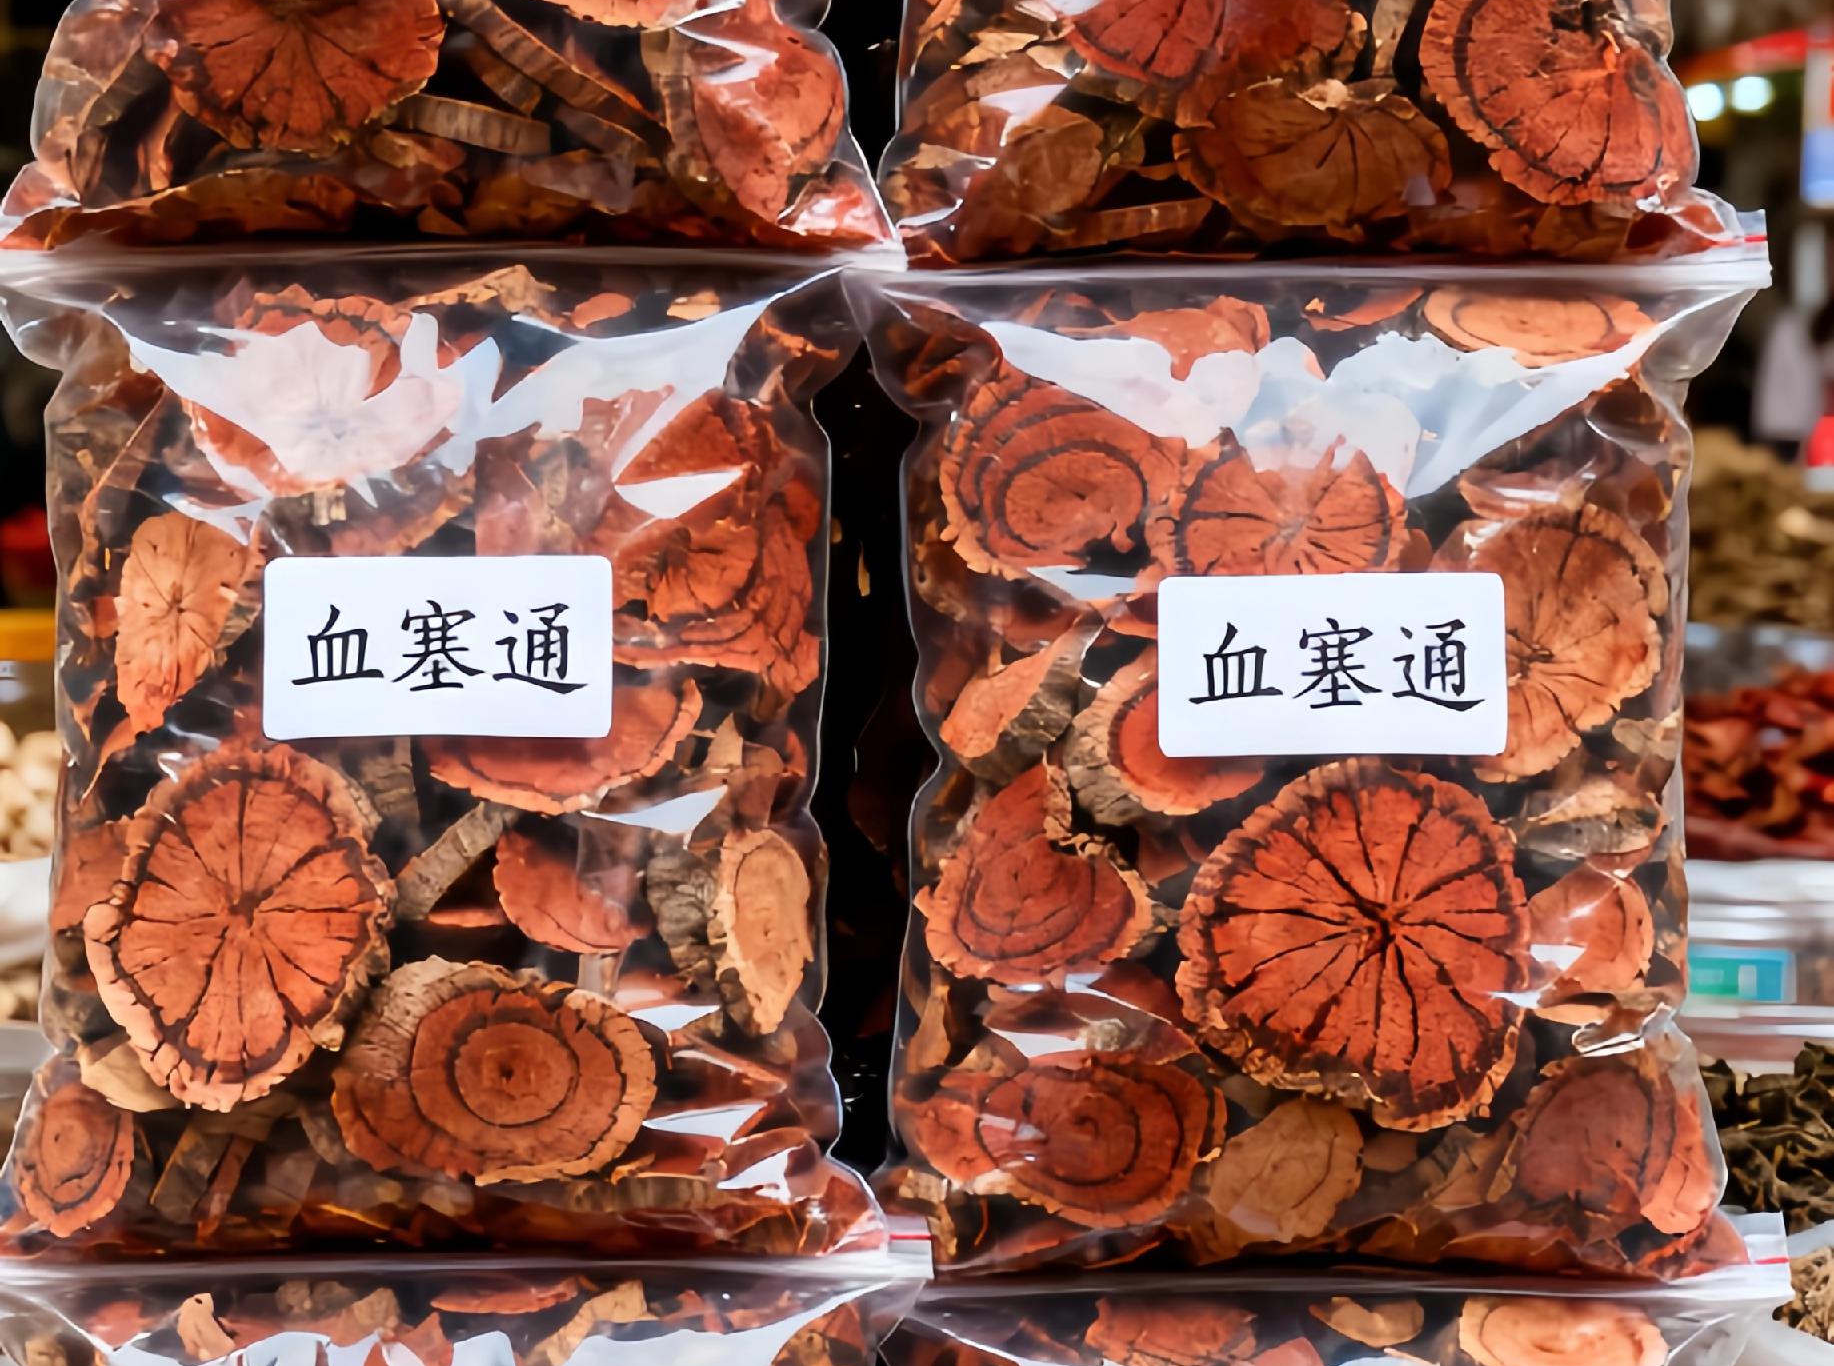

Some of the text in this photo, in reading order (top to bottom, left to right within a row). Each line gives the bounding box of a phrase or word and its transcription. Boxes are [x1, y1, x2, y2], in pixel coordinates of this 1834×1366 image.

[292, 600, 587, 695] 血塞通
[1189, 618, 1485, 712] 血塞通
